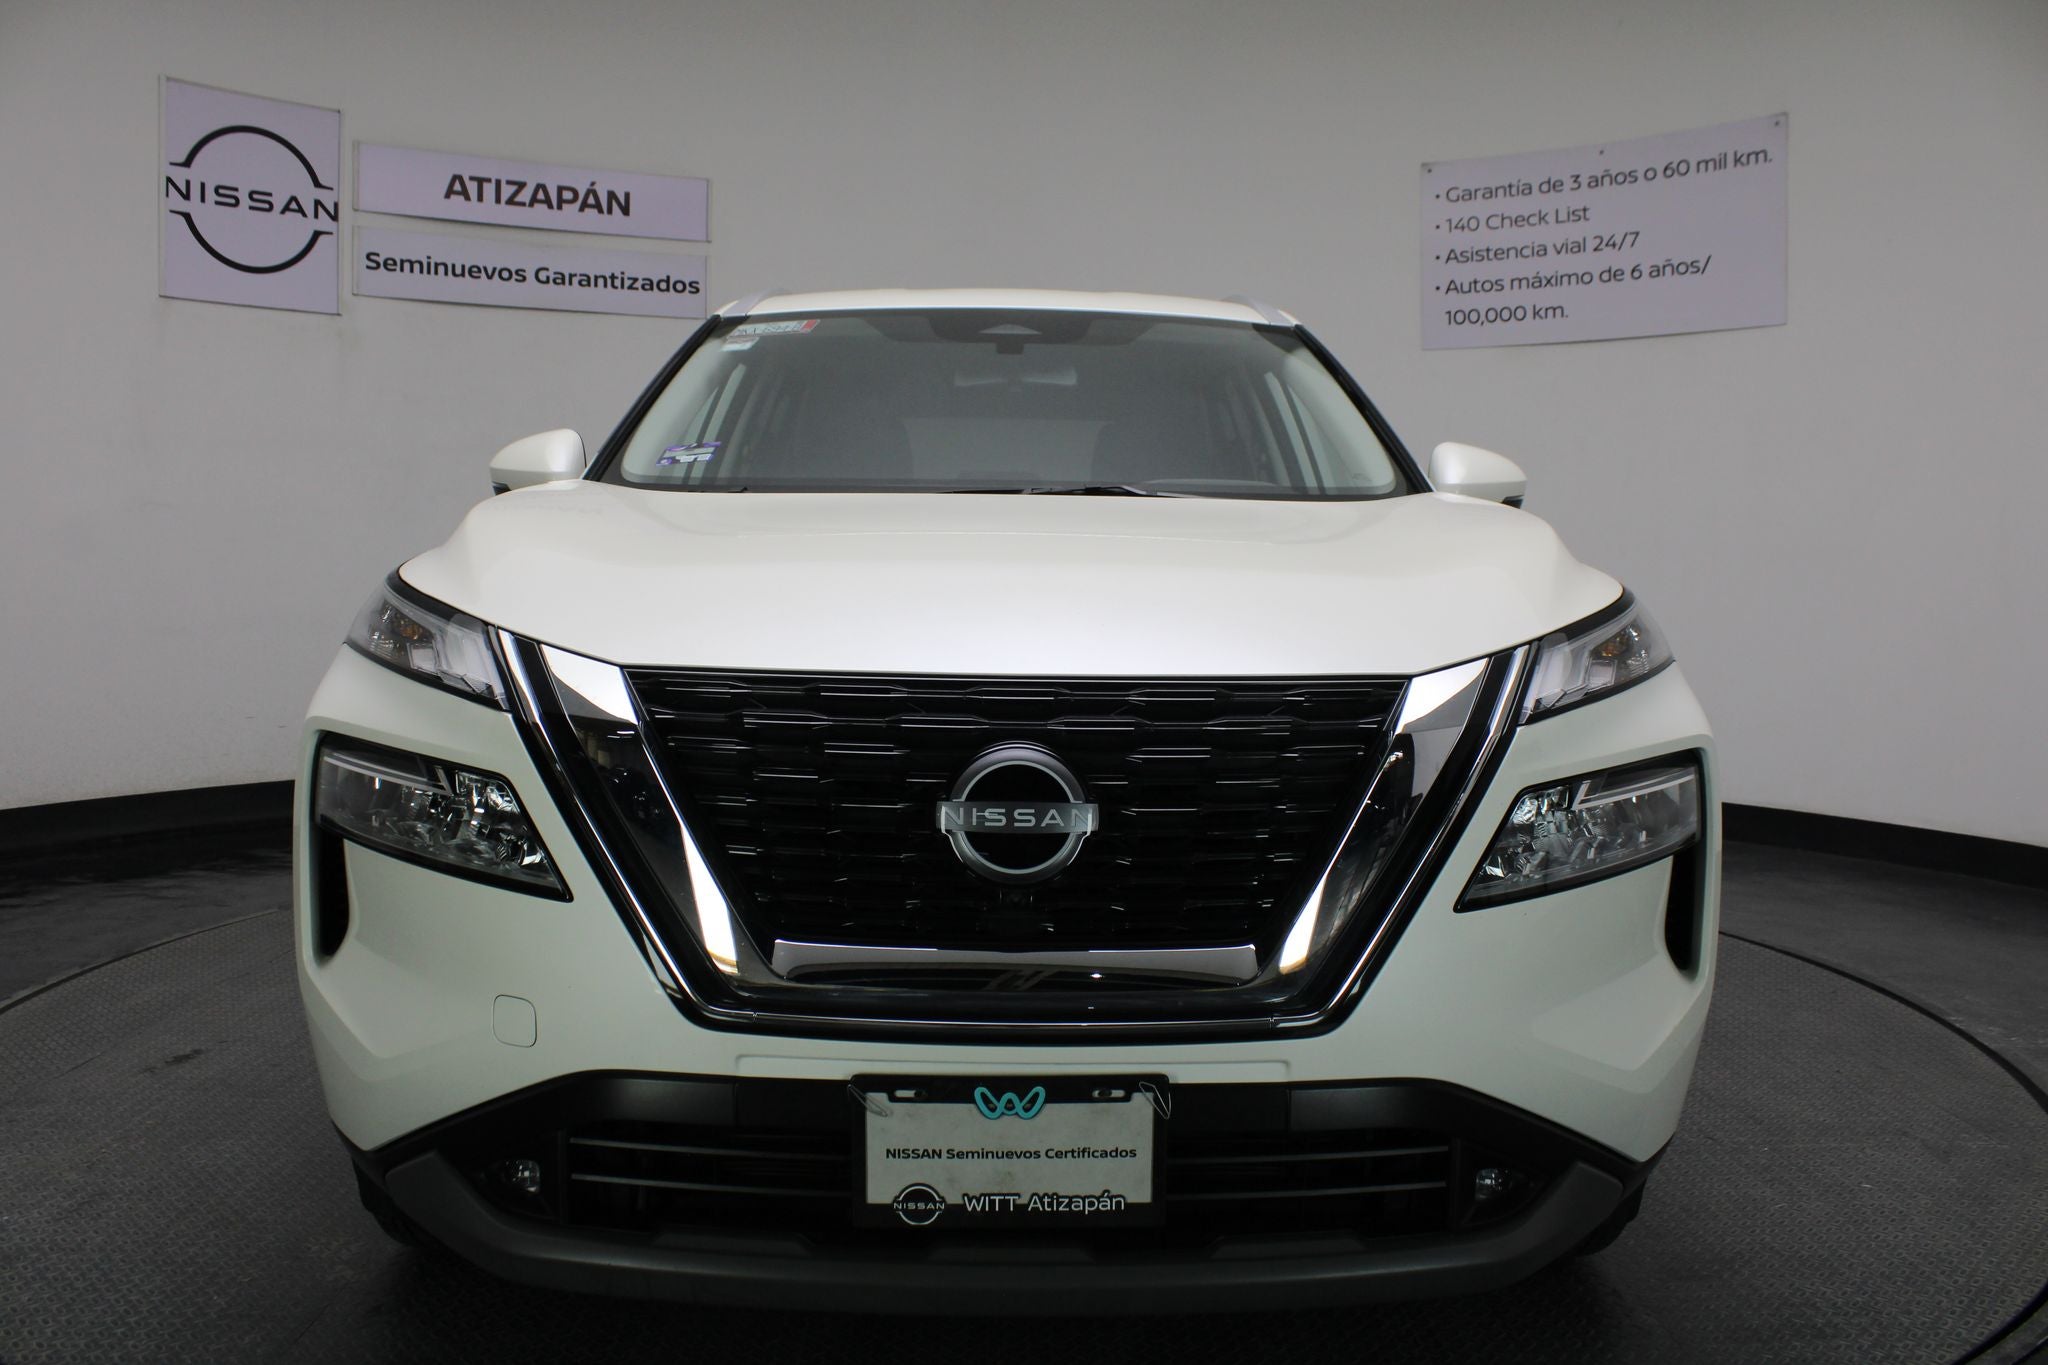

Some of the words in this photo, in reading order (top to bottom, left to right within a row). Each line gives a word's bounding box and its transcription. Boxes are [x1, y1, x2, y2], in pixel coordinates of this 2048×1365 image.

[1445, 176, 1533, 203] Garantía
[1538, 175, 1564, 195] de
[1569, 174, 1582, 191] 3
[1587, 168, 1638, 190] años
[1643, 167, 1657, 182] o
[1663, 159, 1690, 179] 60
[1696, 152, 1727, 174] mil
[1733, 147, 1773, 169] km.
[165, 175, 339, 222] NISSAN
[443, 173, 631, 217] ATIZAPÁN
[1446, 216, 1480, 233] 140
[1486, 208, 1549, 230] Check
[1555, 205, 1590, 224] List
[1445, 242, 1547, 265] Asistencia
[1553, 236, 1587, 256] vial
[1592, 231, 1640, 253] 24/7
[364, 251, 527, 284] Seminuevos
[533, 266, 700, 295] Garantizados
[1445, 274, 1505, 295] Autos
[1510, 270, 1593, 291] máximo
[1599, 265, 1625, 284] de
[1631, 263, 1643, 281] 6
[1648, 255, 1712, 279] años/
[1445, 306, 1527, 327] 100,000
[1532, 303, 1569, 321] km.
[941, 806, 1092, 827] NISSAN
[886, 1148, 942, 1160] NISSAN
[946, 1148, 1041, 1160] Seminuevos
[1045, 1147, 1137, 1159] Certificados
[893, 1201, 945, 1210] NISSAN
[964, 1196, 1019, 1211] WITT
[1028, 1192, 1125, 1215] Atizapán
